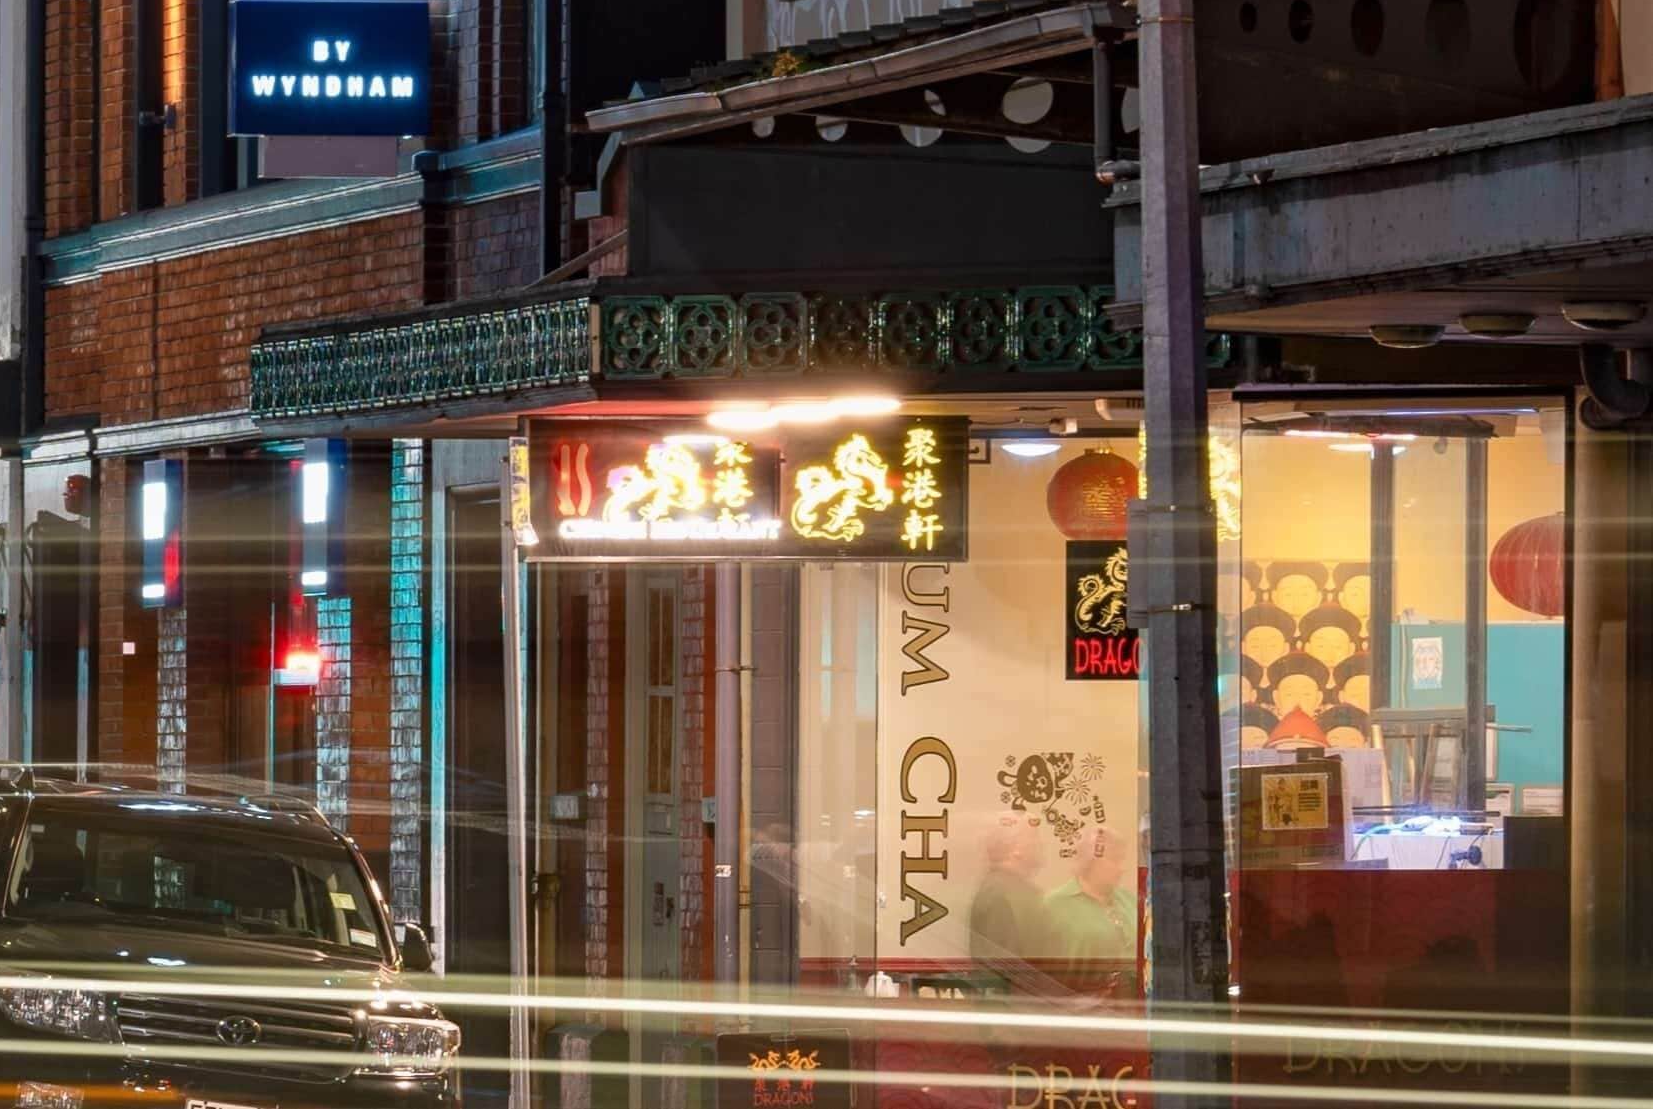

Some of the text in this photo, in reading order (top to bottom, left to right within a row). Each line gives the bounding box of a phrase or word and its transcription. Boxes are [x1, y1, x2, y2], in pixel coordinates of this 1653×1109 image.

[312, 40, 351, 62] BY
[251, 74, 414, 98] WYNDHAM
[900, 736, 957, 946] CHA
